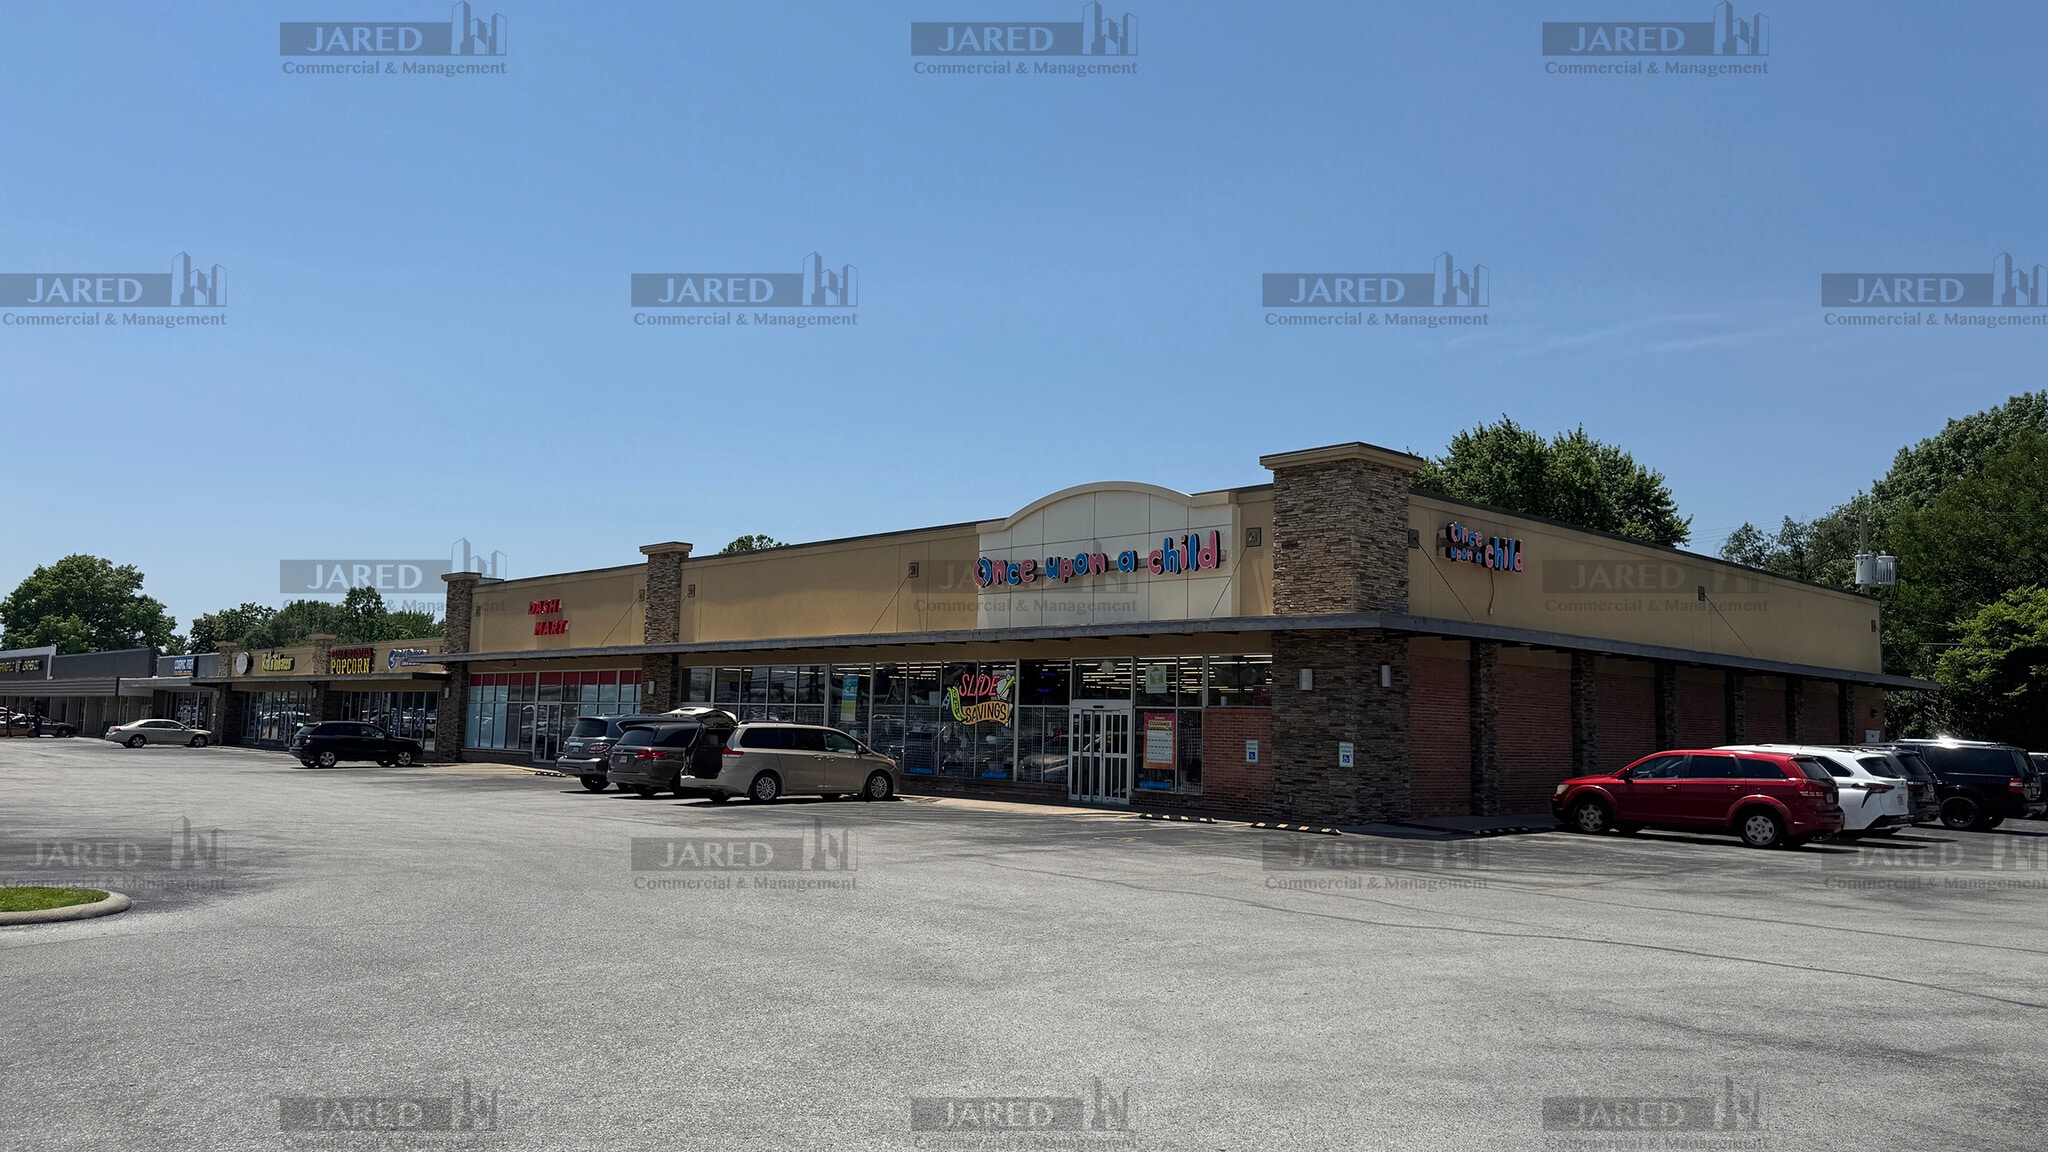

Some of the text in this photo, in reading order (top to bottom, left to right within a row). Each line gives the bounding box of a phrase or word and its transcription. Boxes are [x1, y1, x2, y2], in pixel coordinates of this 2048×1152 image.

[1451, 523, 1482, 547] Once
[973, 557, 1036, 588] Once
[1045, 553, 1106, 583] upon
[1117, 551, 1137, 573] a
[1148, 530, 1221, 575] child
[1451, 547, 1482, 564] upon a
[1485, 537, 1524, 571] child
[528, 599, 561, 615] DASH
[534, 620, 568, 636] MART
[331, 658, 371, 675] POPCORN
[959, 674, 1000, 696] SLIDE
[965, 702, 1006, 722] SAVINGS
